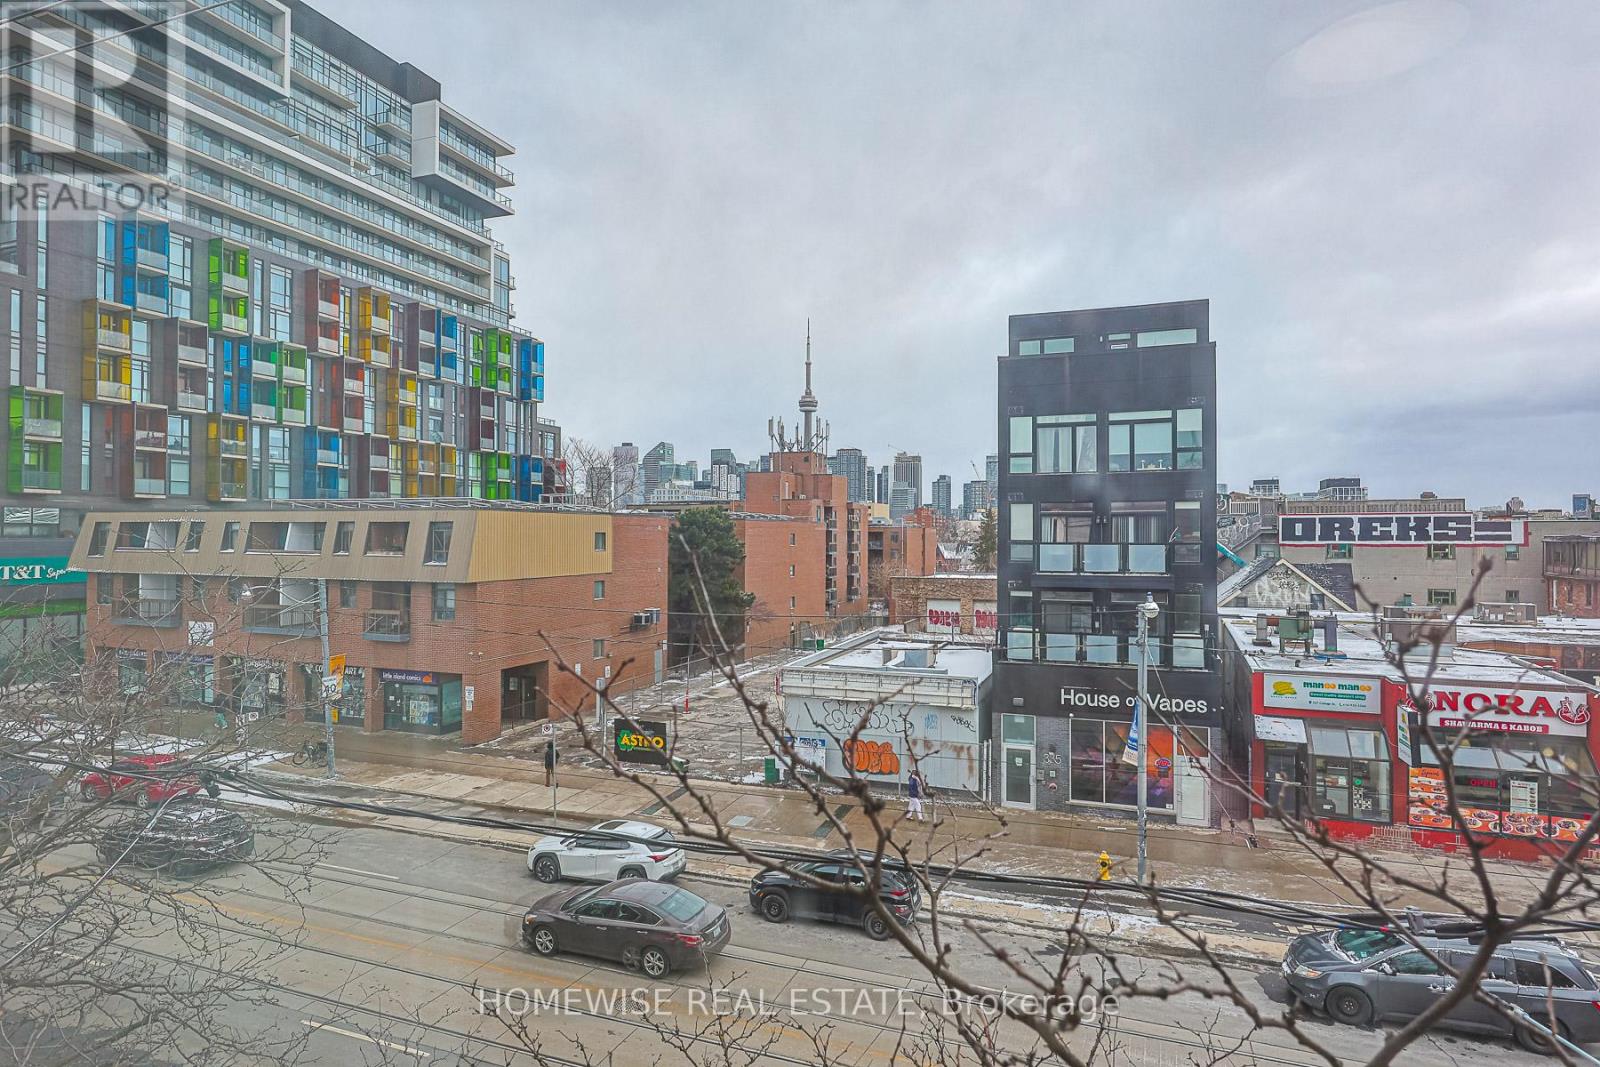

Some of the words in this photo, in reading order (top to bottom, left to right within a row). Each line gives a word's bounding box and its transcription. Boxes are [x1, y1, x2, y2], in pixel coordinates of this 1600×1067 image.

[0, 565, 45, 580] T&T
[1060, 689, 1120, 707] House
[1147, 694, 1208, 714] Vapes
[1433, 690, 1556, 717] NORA
[1509, 724, 1543, 732] KABOB
